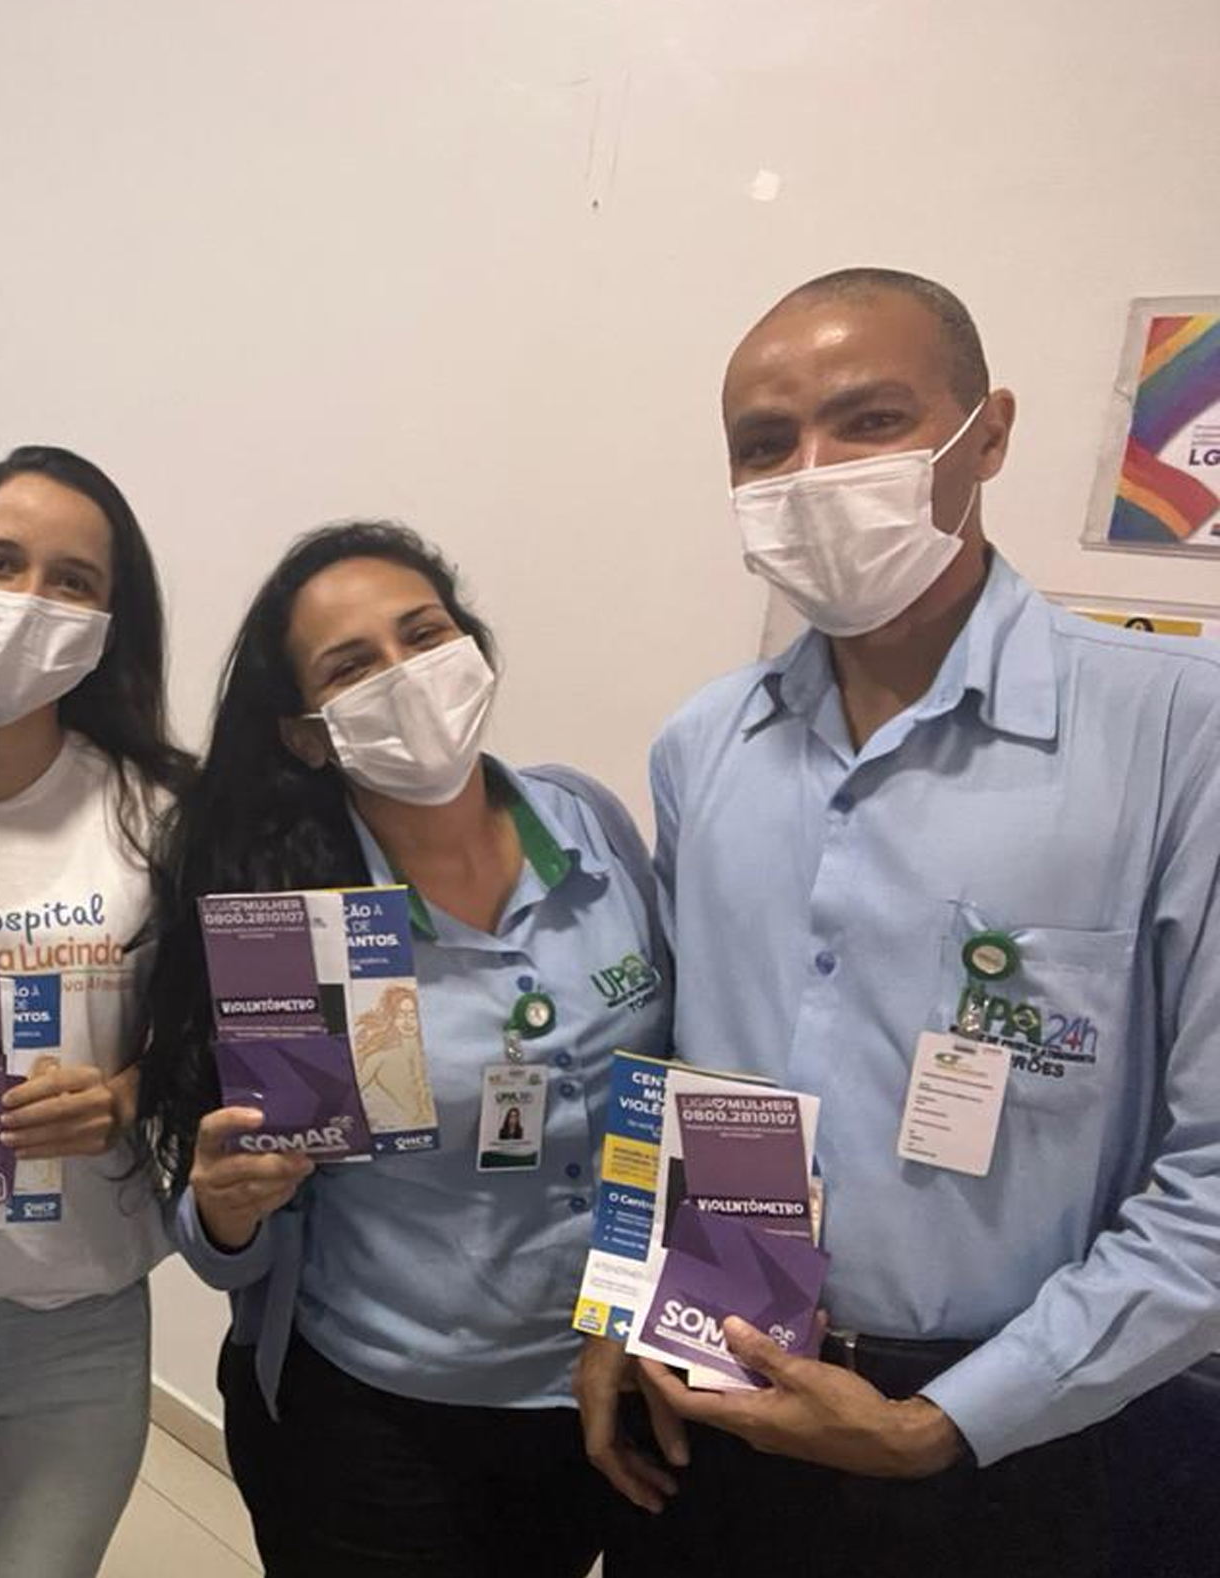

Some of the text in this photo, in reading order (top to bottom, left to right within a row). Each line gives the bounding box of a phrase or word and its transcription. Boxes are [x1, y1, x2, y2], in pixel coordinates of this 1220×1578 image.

[20, 933, 125, 971] Lucinda
[1044, 1013, 1098, 1053] 24h
[1011, 1053, 1065, 1078] RÕES
[619, 1096, 664, 1115] VIOLÊ
[682, 1109, 797, 1125] 0800.2810107
[727, 1099, 793, 1112] MULHER
[239, 1126, 345, 1152] SOMAR
[660, 1300, 728, 1352] SOM
